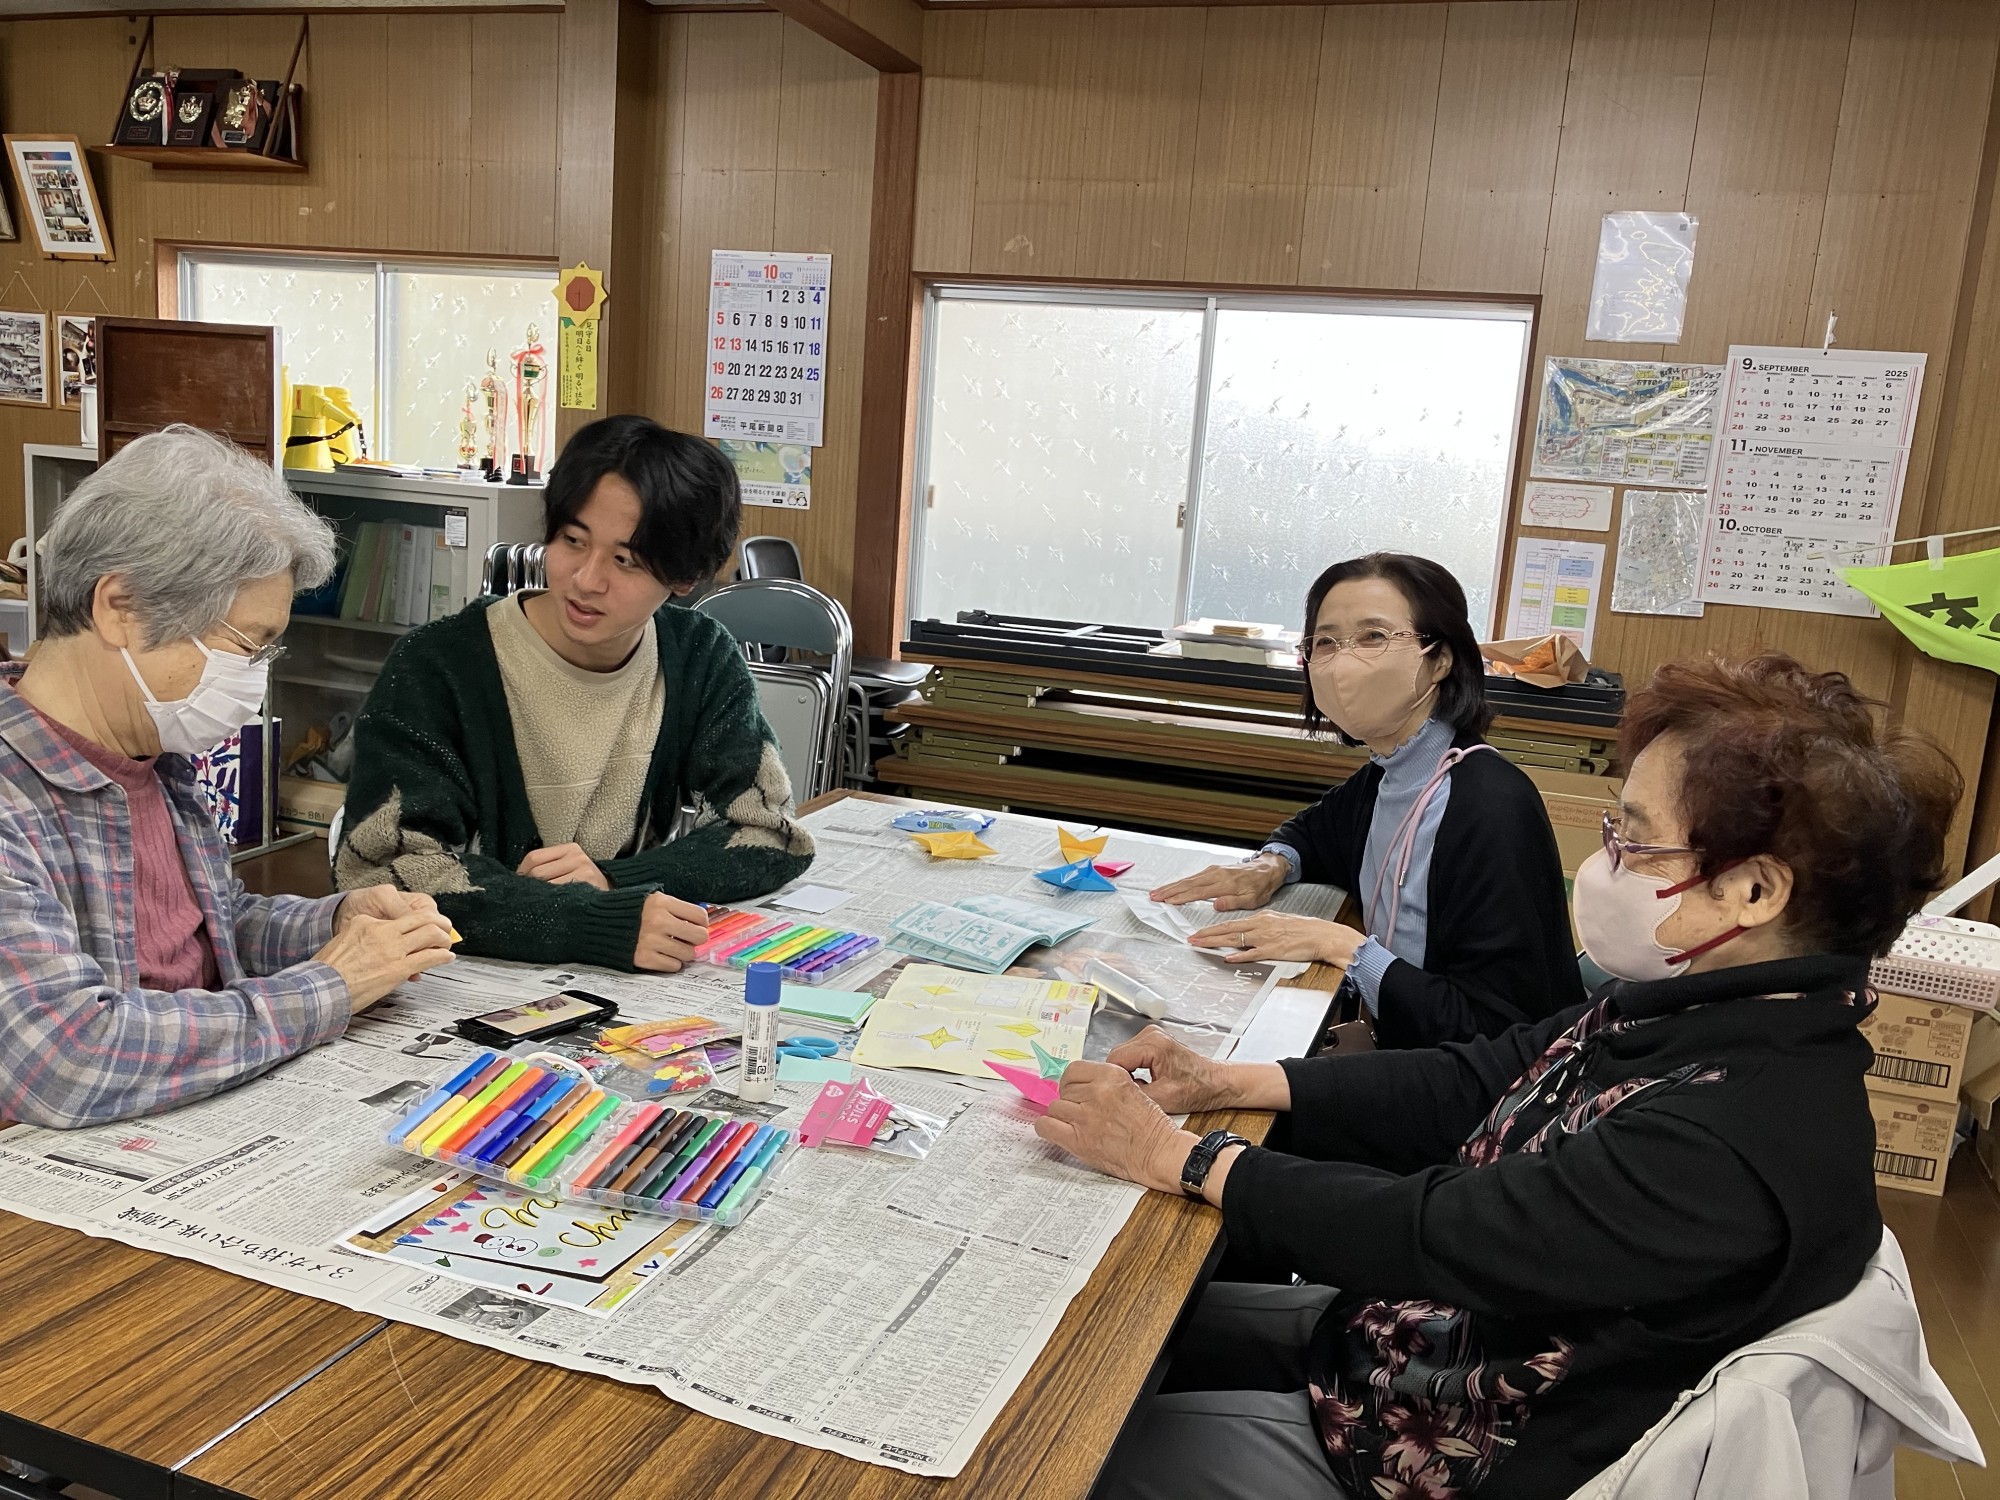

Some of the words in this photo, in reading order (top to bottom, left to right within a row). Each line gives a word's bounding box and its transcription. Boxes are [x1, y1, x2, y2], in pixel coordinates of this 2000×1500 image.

[764, 265, 778, 279] 10
[766, 290, 772, 302] 1
[782, 290, 789, 303] 2
[798, 291, 805, 304] 3
[813, 292, 821, 304] 4
[717, 312, 724, 325] 5
[733, 313, 740, 326] 6
[749, 314, 756, 326] 7
[765, 314, 772, 328] 8
[780, 315, 788, 328] 9
[794, 316, 806, 329] 10
[810, 317, 821, 330] 11
[714, 337, 726, 350] 12
[730, 338, 741, 351] 13
[745, 339, 757, 352] 14
[761, 340, 773, 353] 15
[777, 341, 789, 354] 16
[793, 342, 805, 355] 17
[809, 342, 820, 356] 18
[712, 362, 724, 375] 19
[728, 362, 740, 376] 20
[744, 363, 755, 376] 21
[759, 364, 772, 378] 22
[775, 365, 787, 379] 23
[790, 366, 803, 380] 24
[806, 368, 819, 381] 25
[1758, 364, 1809, 373] SEPTEMBER
[711, 386, 723, 399] 26
[726, 387, 739, 400] 27
[741, 388, 755, 402] 28
[757, 389, 770, 403] 29
[773, 391, 786, 404] 30
[790, 392, 801, 405] 31
[1755, 446, 1803, 455] NOVEMBER
[1742, 526, 1782, 534] OCTOBER
